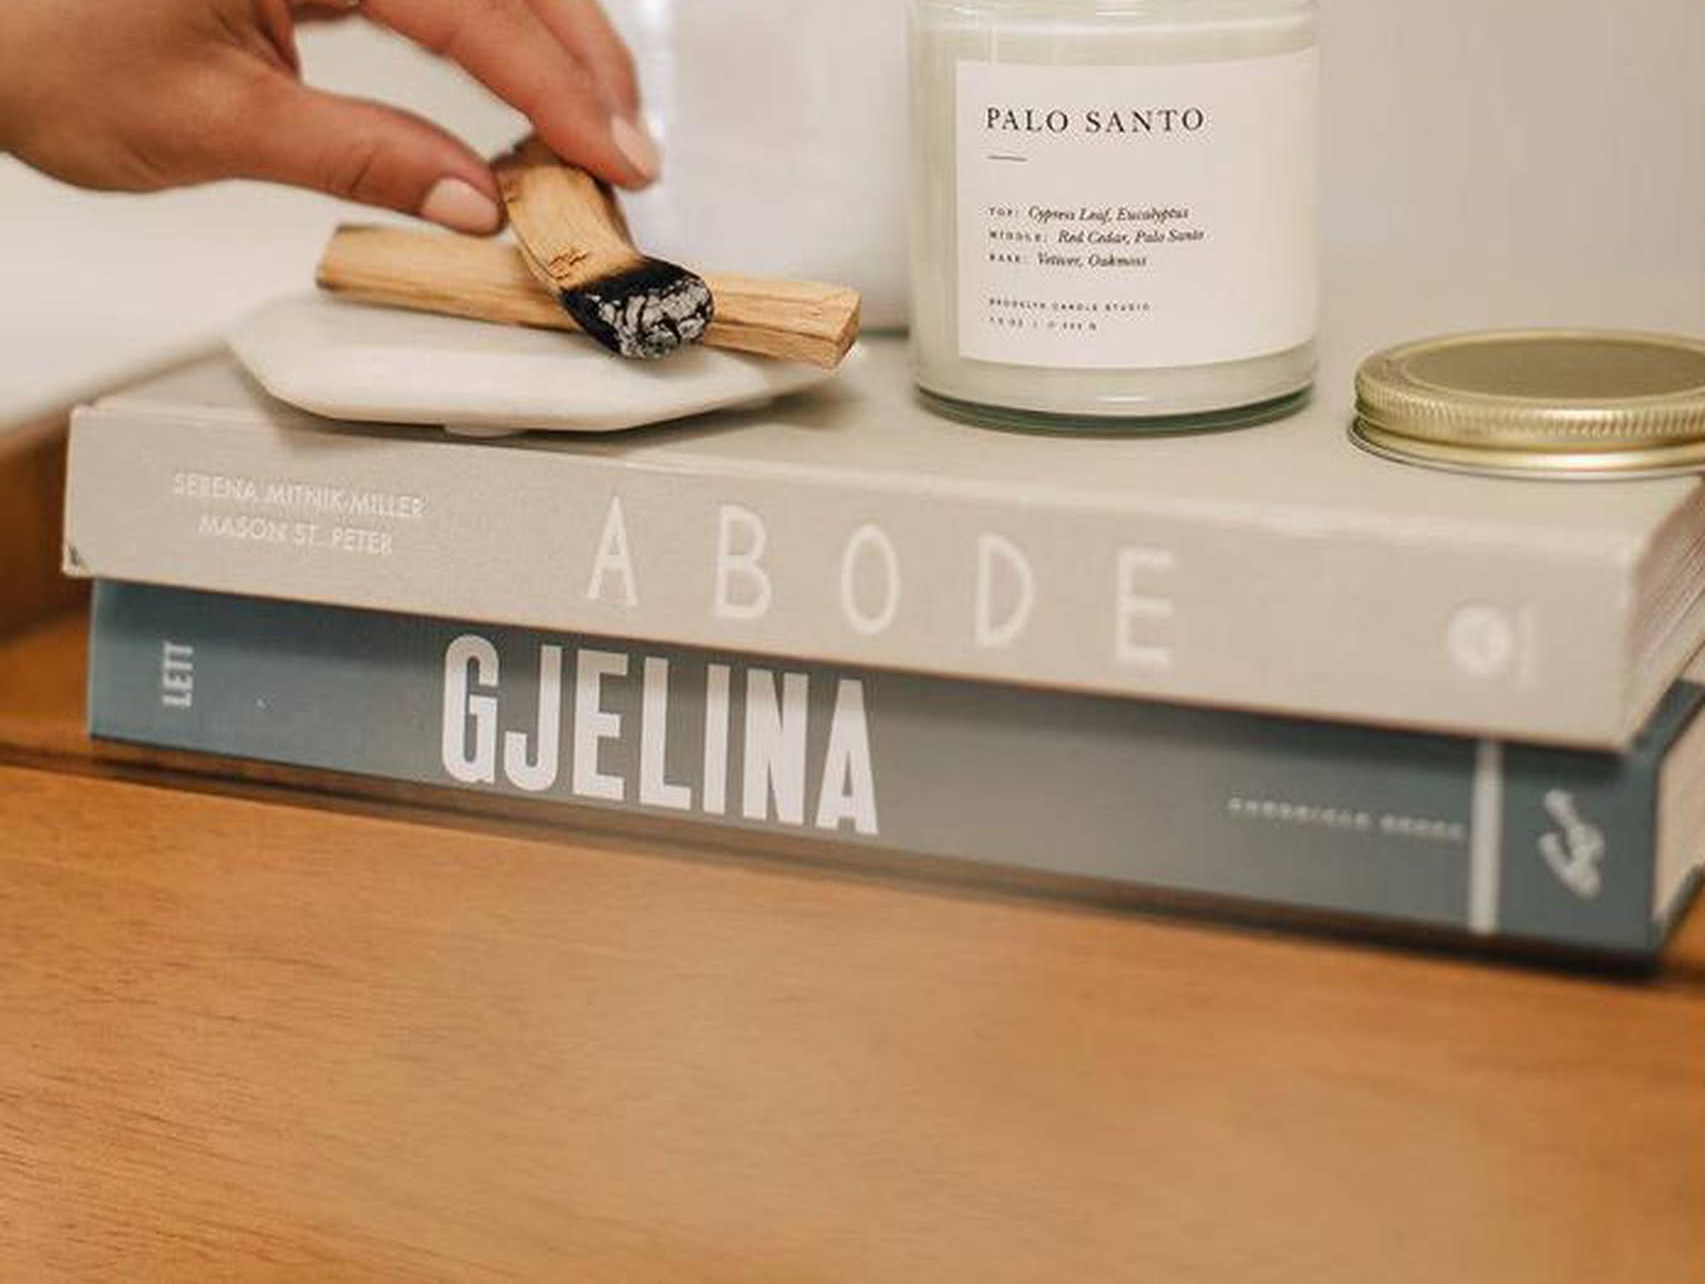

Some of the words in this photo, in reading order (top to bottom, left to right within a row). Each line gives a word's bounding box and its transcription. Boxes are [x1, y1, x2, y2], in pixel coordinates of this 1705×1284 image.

[985, 107, 1069, 133] PALO
[1085, 107, 1205, 133] SANTO
[1027, 206, 1075, 224] Cypress
[1078, 207, 1112, 224] Leaf,
[1116, 207, 1189, 224] Eucalyptus
[1057, 230, 1083, 243] Red
[1087, 230, 1131, 245] Cedar,
[1134, 230, 1164, 243] Palo
[1168, 229, 1204, 242] Santo
[1037, 253, 1083, 268] Vetiver,
[197, 514, 287, 541] MASON
[331, 526, 394, 556] PETER
[161, 639, 195, 710] LETT
[440, 633, 881, 837] GJELINA
